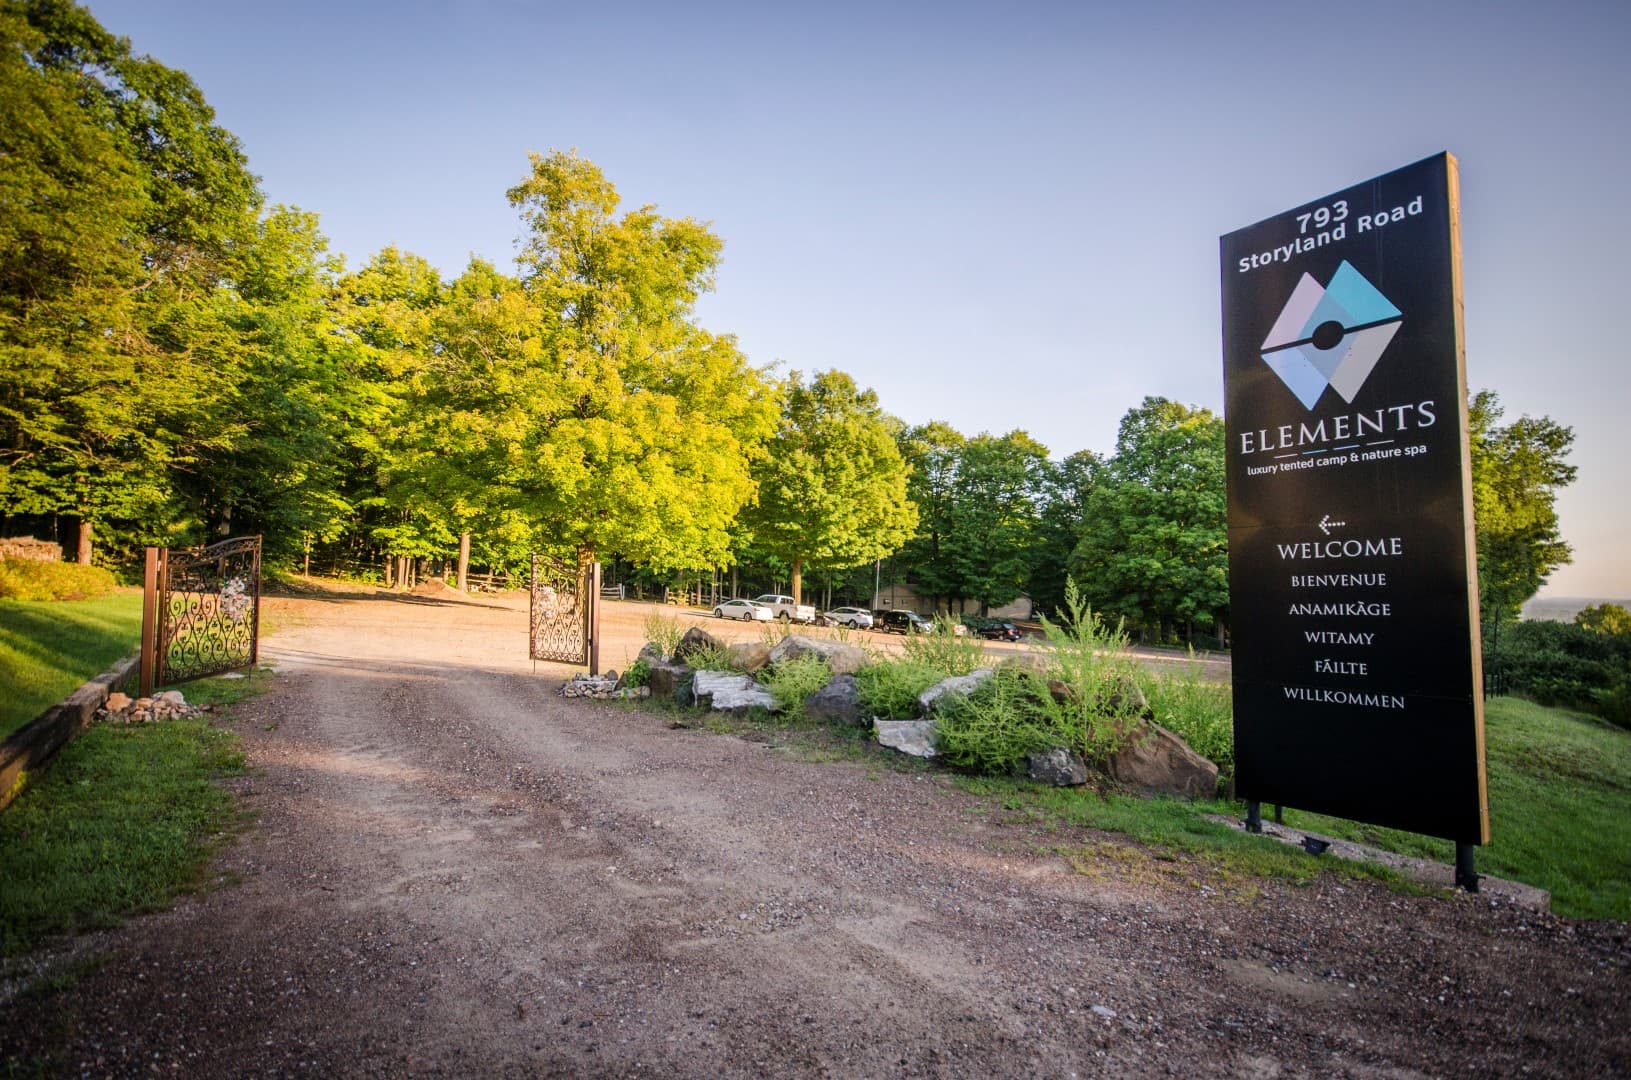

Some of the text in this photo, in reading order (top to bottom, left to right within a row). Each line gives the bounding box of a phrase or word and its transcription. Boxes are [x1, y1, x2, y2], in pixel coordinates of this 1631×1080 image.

[1296, 199, 1349, 234] 793
[1238, 195, 1423, 273] Storyland Road
[1239, 400, 1436, 455] ELEMENTS
[1247, 445, 1427, 476] luxury tented camp & nature spa
[1276, 537, 1403, 560] WELCOME
[1291, 573, 1387, 587] BIENVENUE
[1304, 631, 1375, 645] WITAMY
[1283, 687, 1406, 709] WILLKOMMEN
